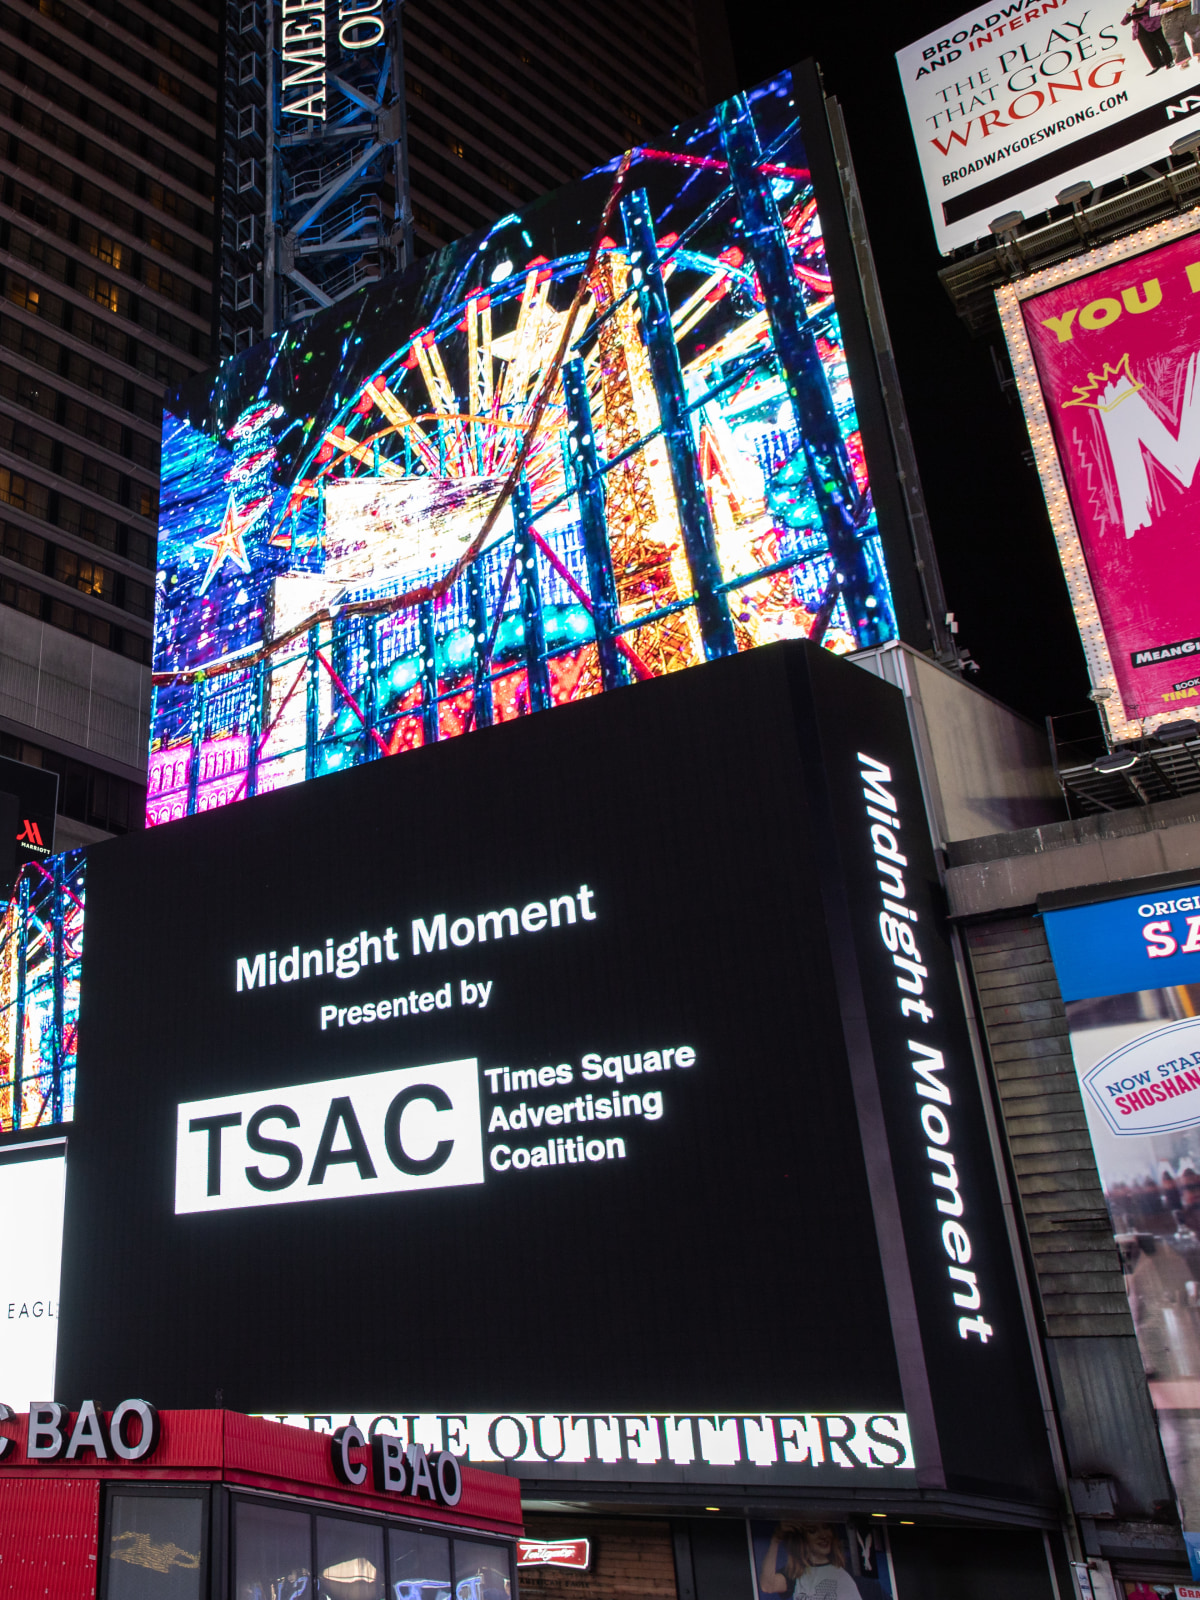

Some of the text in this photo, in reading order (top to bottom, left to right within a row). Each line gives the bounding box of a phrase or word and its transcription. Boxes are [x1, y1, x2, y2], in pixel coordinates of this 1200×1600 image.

[916, 49, 962, 80] AND
[926, 24, 1119, 130] THAT GOES
[935, 10, 1091, 103] THE PLAY
[929, 58, 1126, 157] WRONG
[942, 90, 1129, 186] BROADWAYGOESWRONG.COM
[1041, 277, 1163, 343] YOU
[1161, 687, 1199, 702] TINA
[20, 841, 51, 855] MARRIOTT
[235, 883, 597, 992] Midnight Moment
[321, 979, 493, 1031] Presented by
[484, 1045, 697, 1094] Times Square
[856, 751, 993, 1344] Midnight Moment
[488, 1089, 663, 1133] Advertising
[1105, 1070, 1151, 1096] NOW
[188, 1083, 455, 1197] TSAC
[490, 1135, 626, 1172] Coalition
[8, 1299, 59, 1320] EAGL
[27, 1399, 155, 1460] BAO
[487, 1414, 907, 1468] OUTFITTERS
[338, 1425, 462, 1507] C BAO
